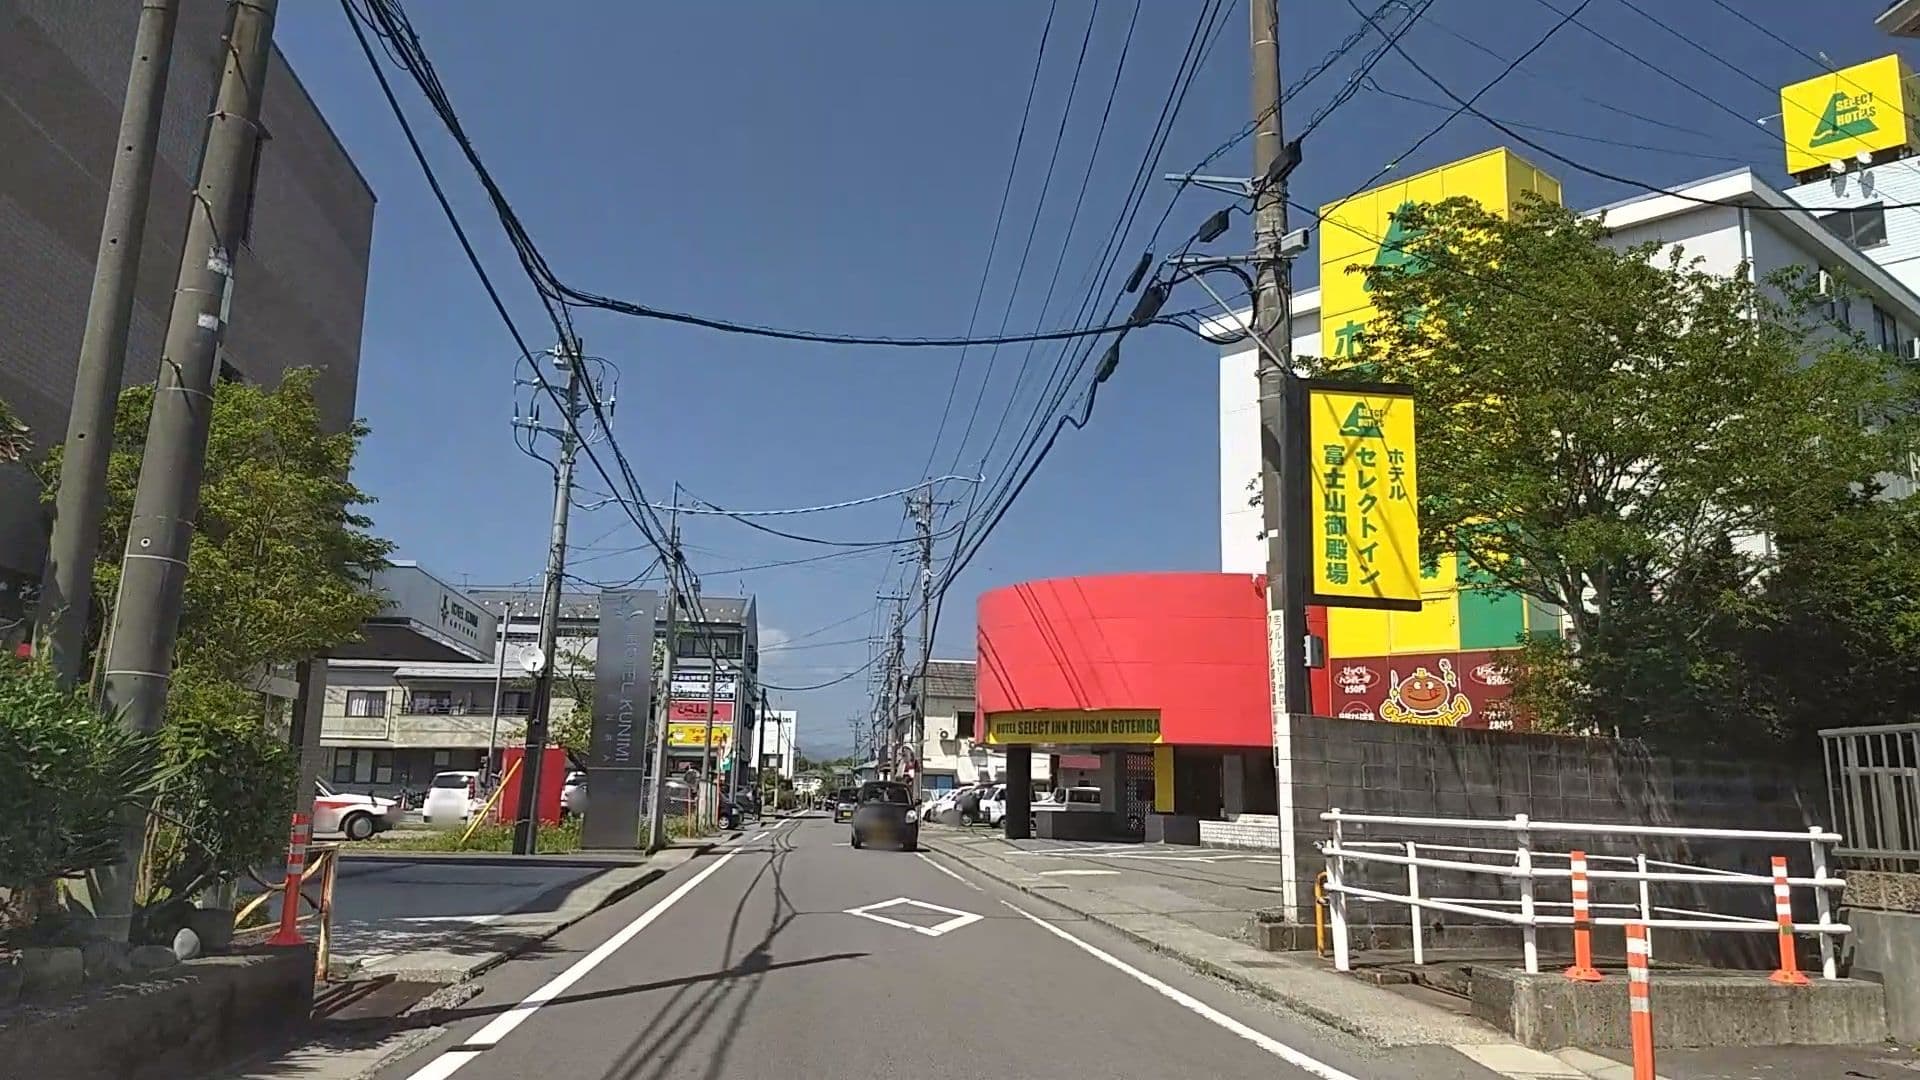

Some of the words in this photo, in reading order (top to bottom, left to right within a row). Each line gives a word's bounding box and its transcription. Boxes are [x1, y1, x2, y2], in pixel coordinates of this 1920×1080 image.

[1836, 92, 1874, 111] SELECT
[1836, 106, 1877, 125] HOTELS
[1388, 449, 1406, 500] ホテル
[1323, 444, 1348, 584] 富士山御殿場
[1356, 447, 1380, 585] セレクトイン
[615, 699, 634, 761] KUNIMI
[996, 722, 1017, 735] HOTEL
[1017, 720, 1050, 735] SELECT
[1051, 720, 1069, 735] INN
[1070, 719, 1109, 735] FUJISAN
[1110, 718, 1161, 734] GOTEMBA
